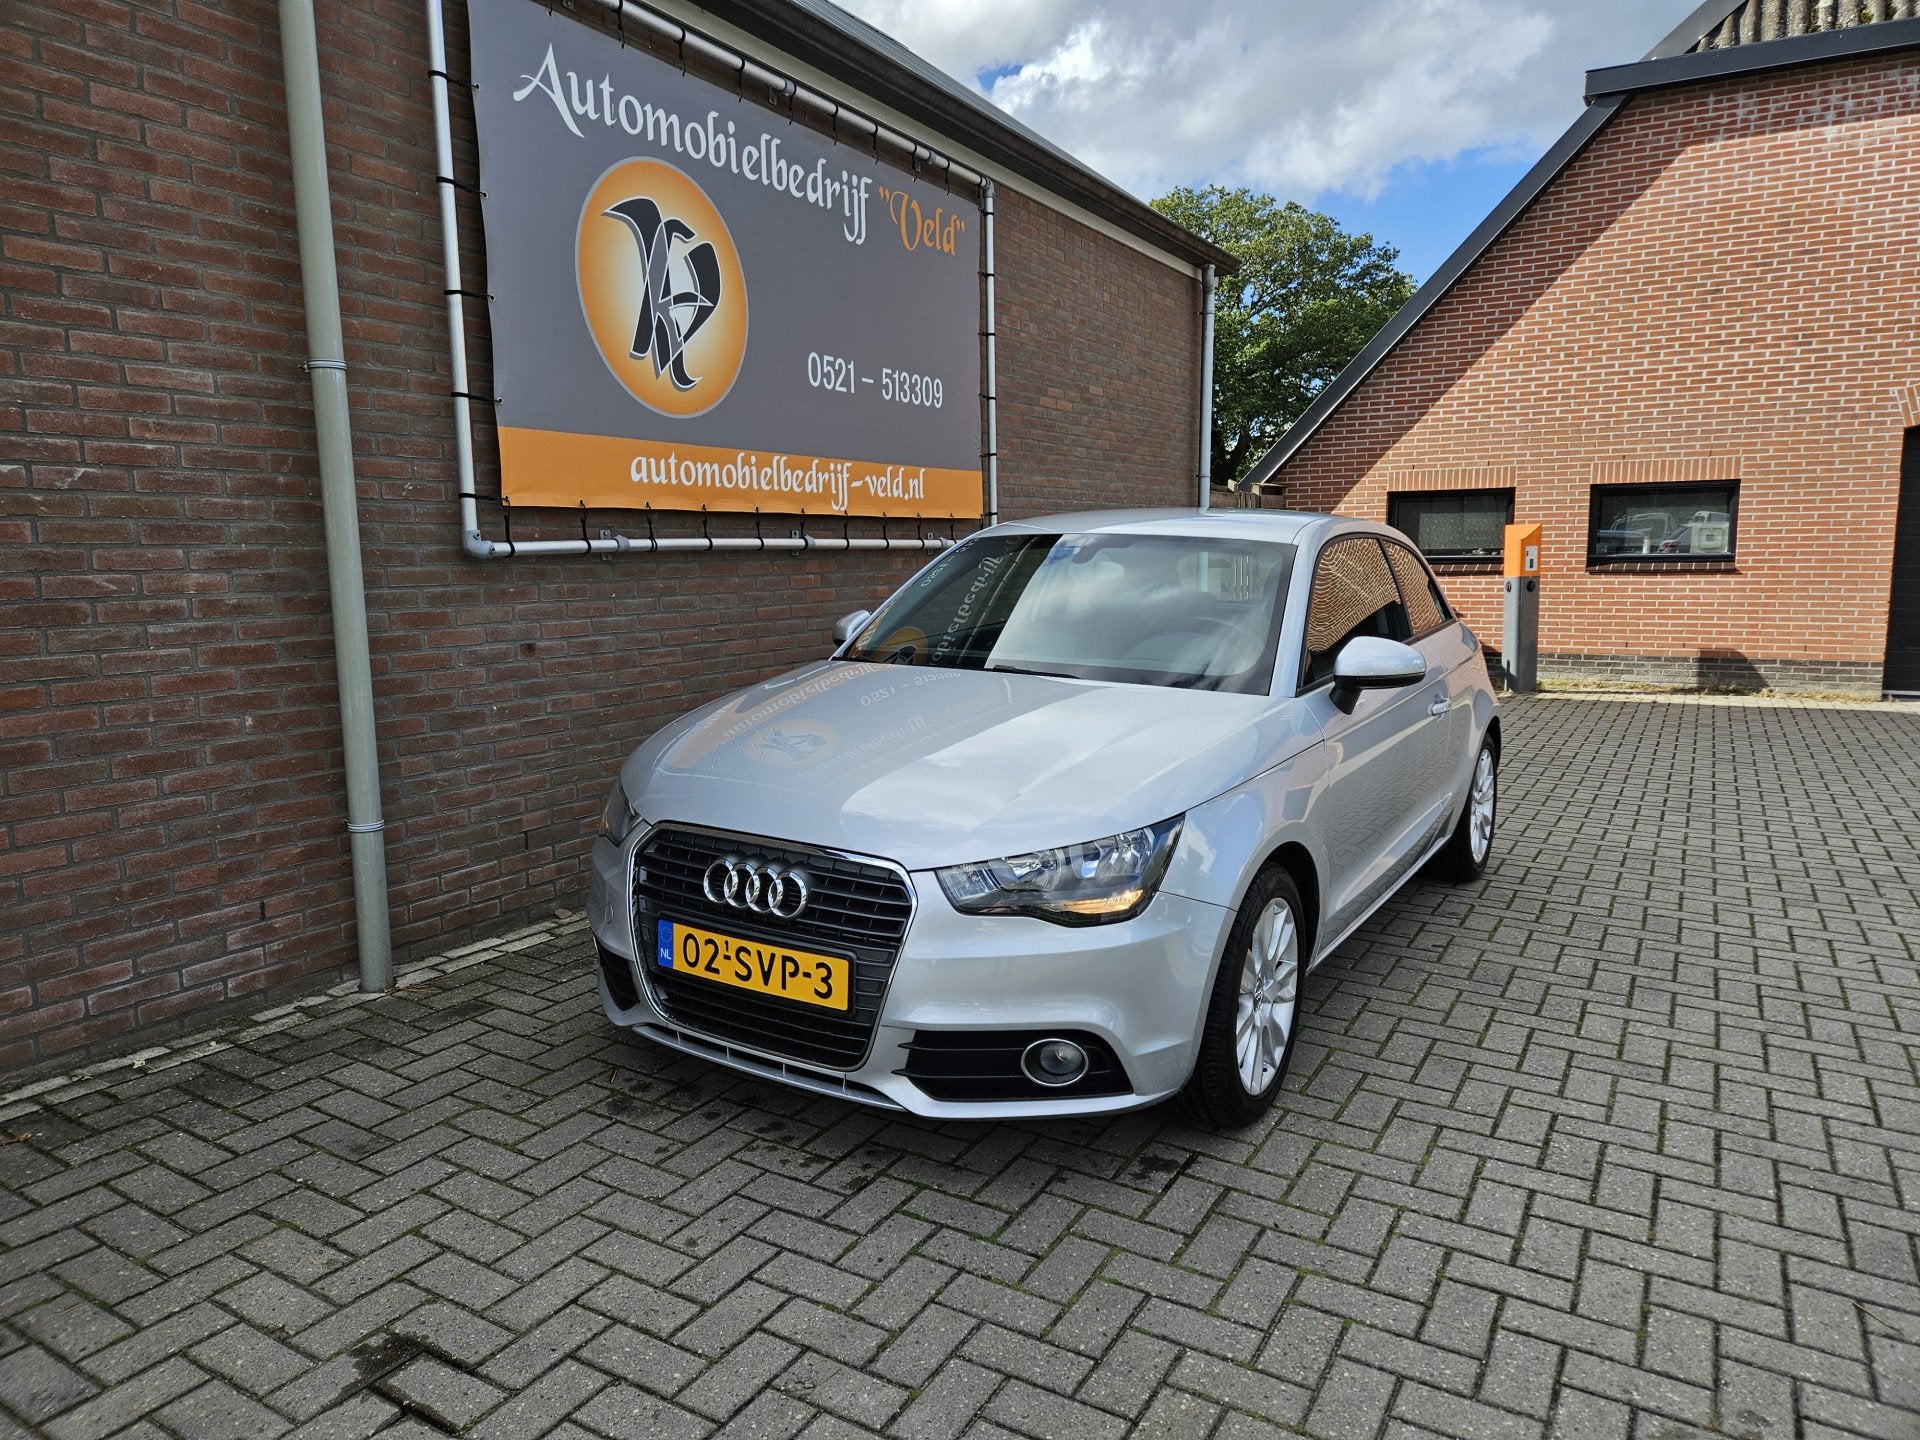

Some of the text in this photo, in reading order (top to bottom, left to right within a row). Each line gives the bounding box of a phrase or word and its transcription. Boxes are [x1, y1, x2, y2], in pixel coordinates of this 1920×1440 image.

[513, 43, 873, 245] Automobielbedrijf
[807, 351, 856, 394] 0521
[882, 367, 943, 408] 513309
[630, 451, 926, 511] automobielbedrijf-veld.nl
[660, 947, 672, 960] NL
